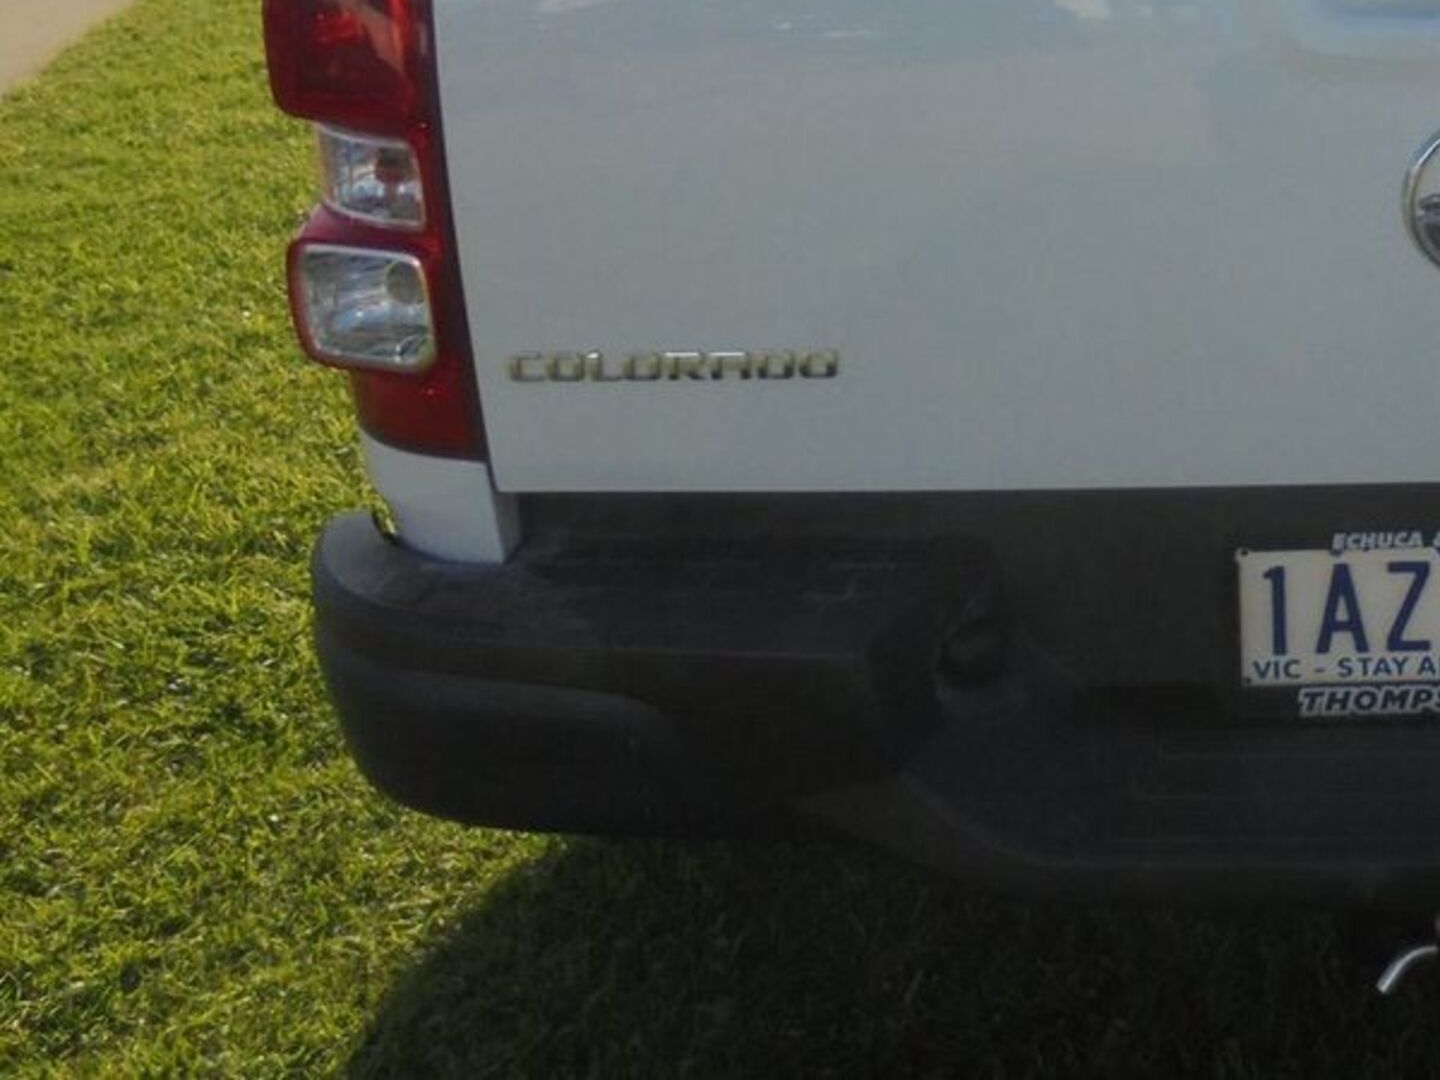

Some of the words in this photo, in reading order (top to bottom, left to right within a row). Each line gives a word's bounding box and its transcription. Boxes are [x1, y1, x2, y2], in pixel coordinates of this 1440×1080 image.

[507, 348, 840, 383] COLORADO
[1331, 532, 1423, 551] ECHUCA
[1262, 561, 1433, 656] 1AZ
[1253, 660, 1302, 680] VIC
[1338, 658, 1406, 678] STAY
